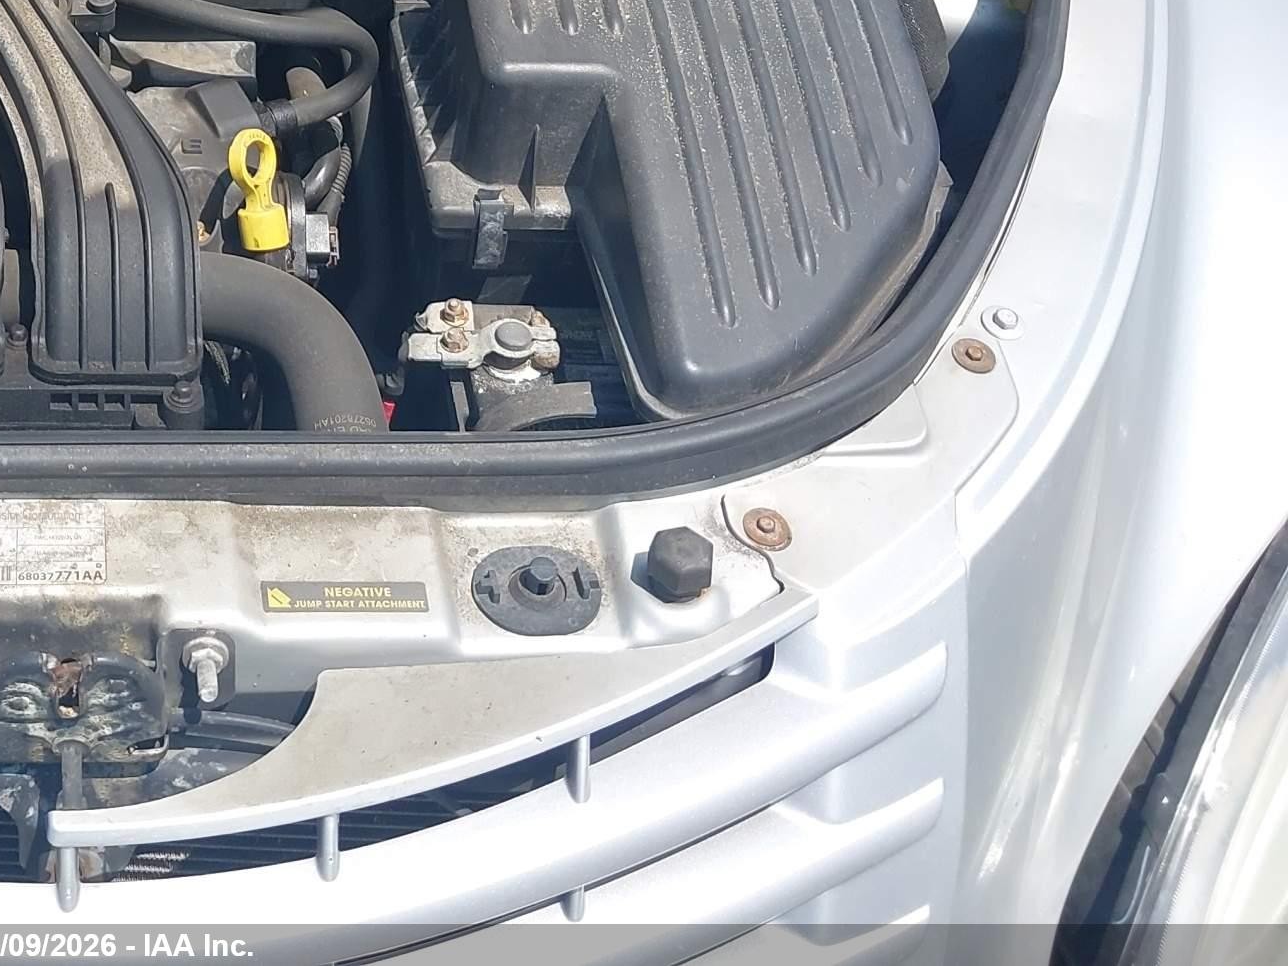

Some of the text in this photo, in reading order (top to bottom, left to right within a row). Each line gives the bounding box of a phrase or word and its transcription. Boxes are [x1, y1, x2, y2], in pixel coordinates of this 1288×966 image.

[18, 570, 104, 581] 68037771AA
[324, 586, 392, 598] NEGATIVE
[294, 599, 426, 609] JUMP START ATTACHMENT
